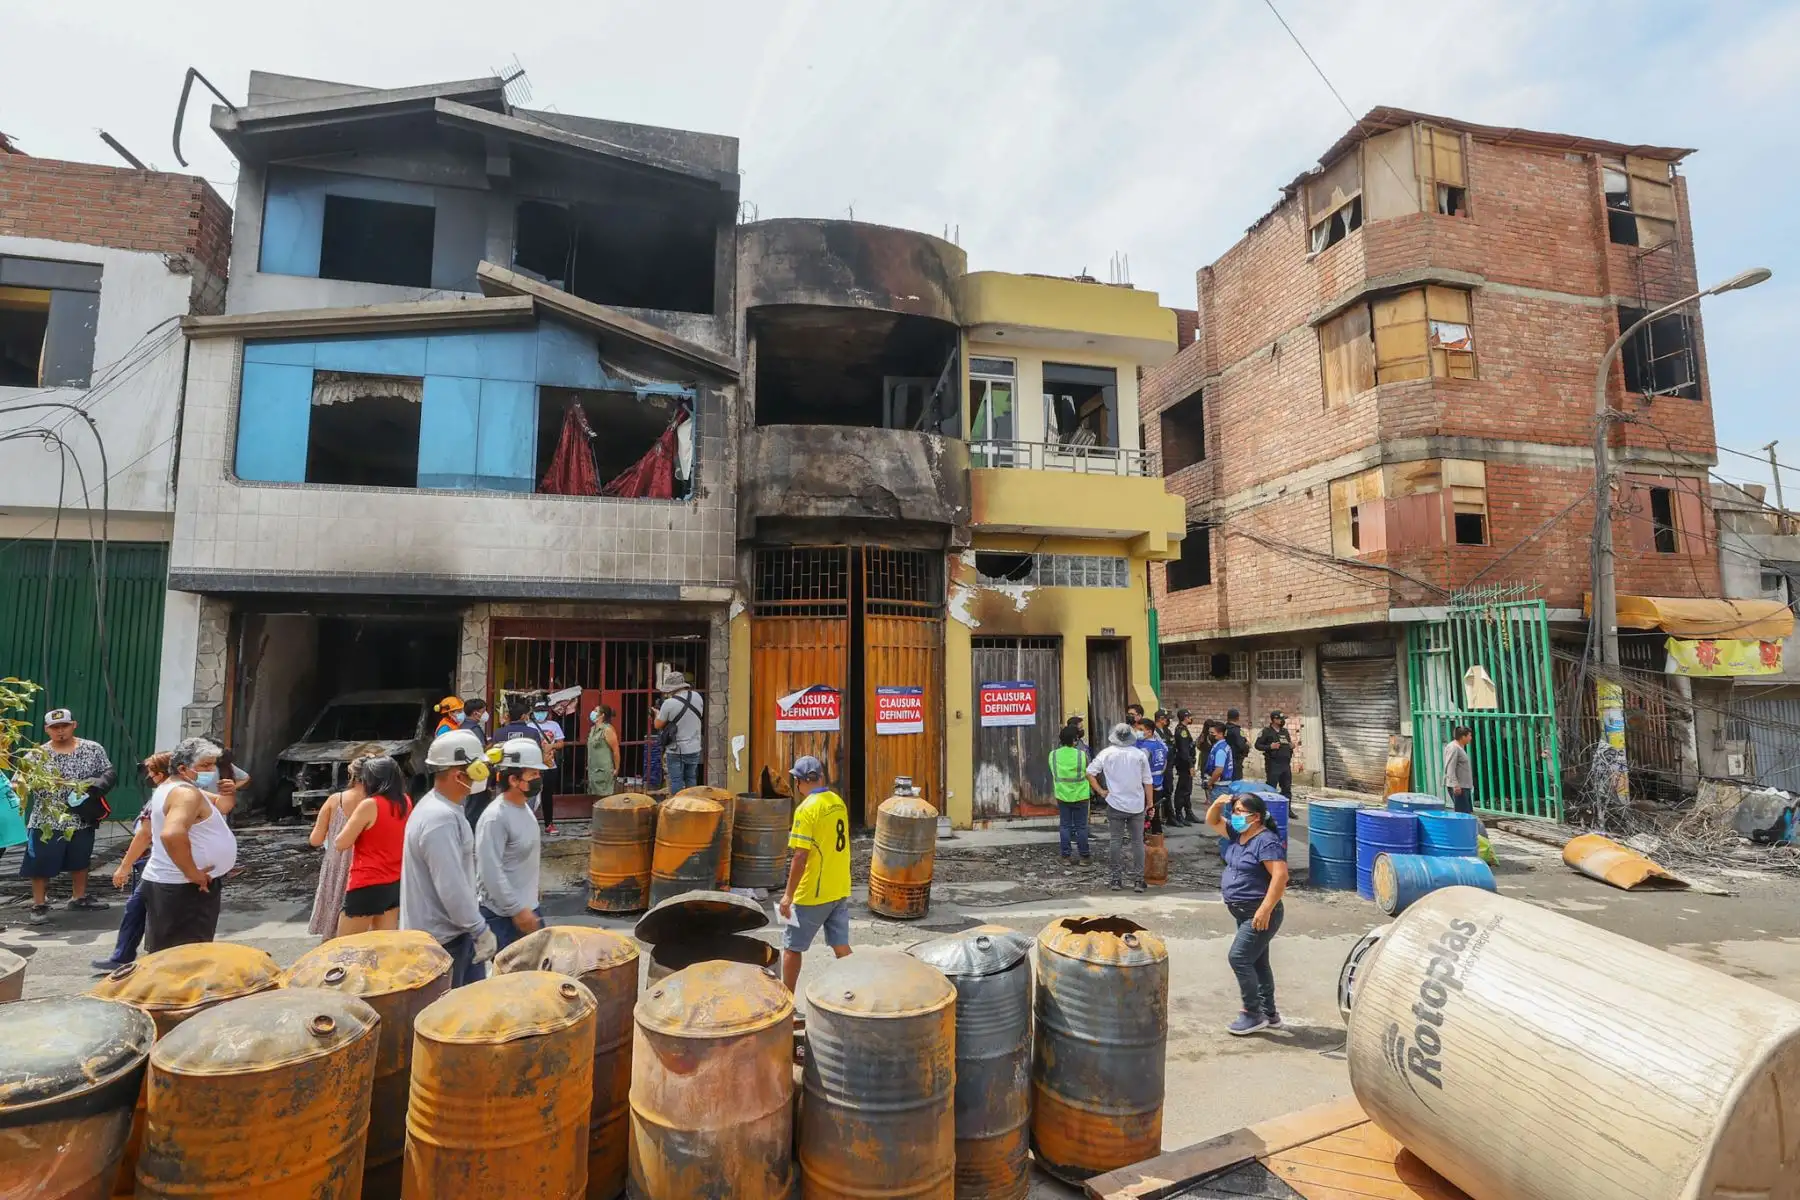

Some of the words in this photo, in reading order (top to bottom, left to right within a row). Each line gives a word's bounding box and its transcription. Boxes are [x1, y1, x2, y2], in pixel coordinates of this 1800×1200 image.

[880, 697, 921, 708] CLAUSURA
[984, 692, 1032, 702] CLAUSURA
[781, 706, 835, 717] DEFINITIVA
[984, 703, 1032, 713] DEFINITIVA
[880, 709, 921, 720] DEFINITIVA
[835, 818, 846, 852] 8
[1408, 918, 1477, 1090] Rotoplas
